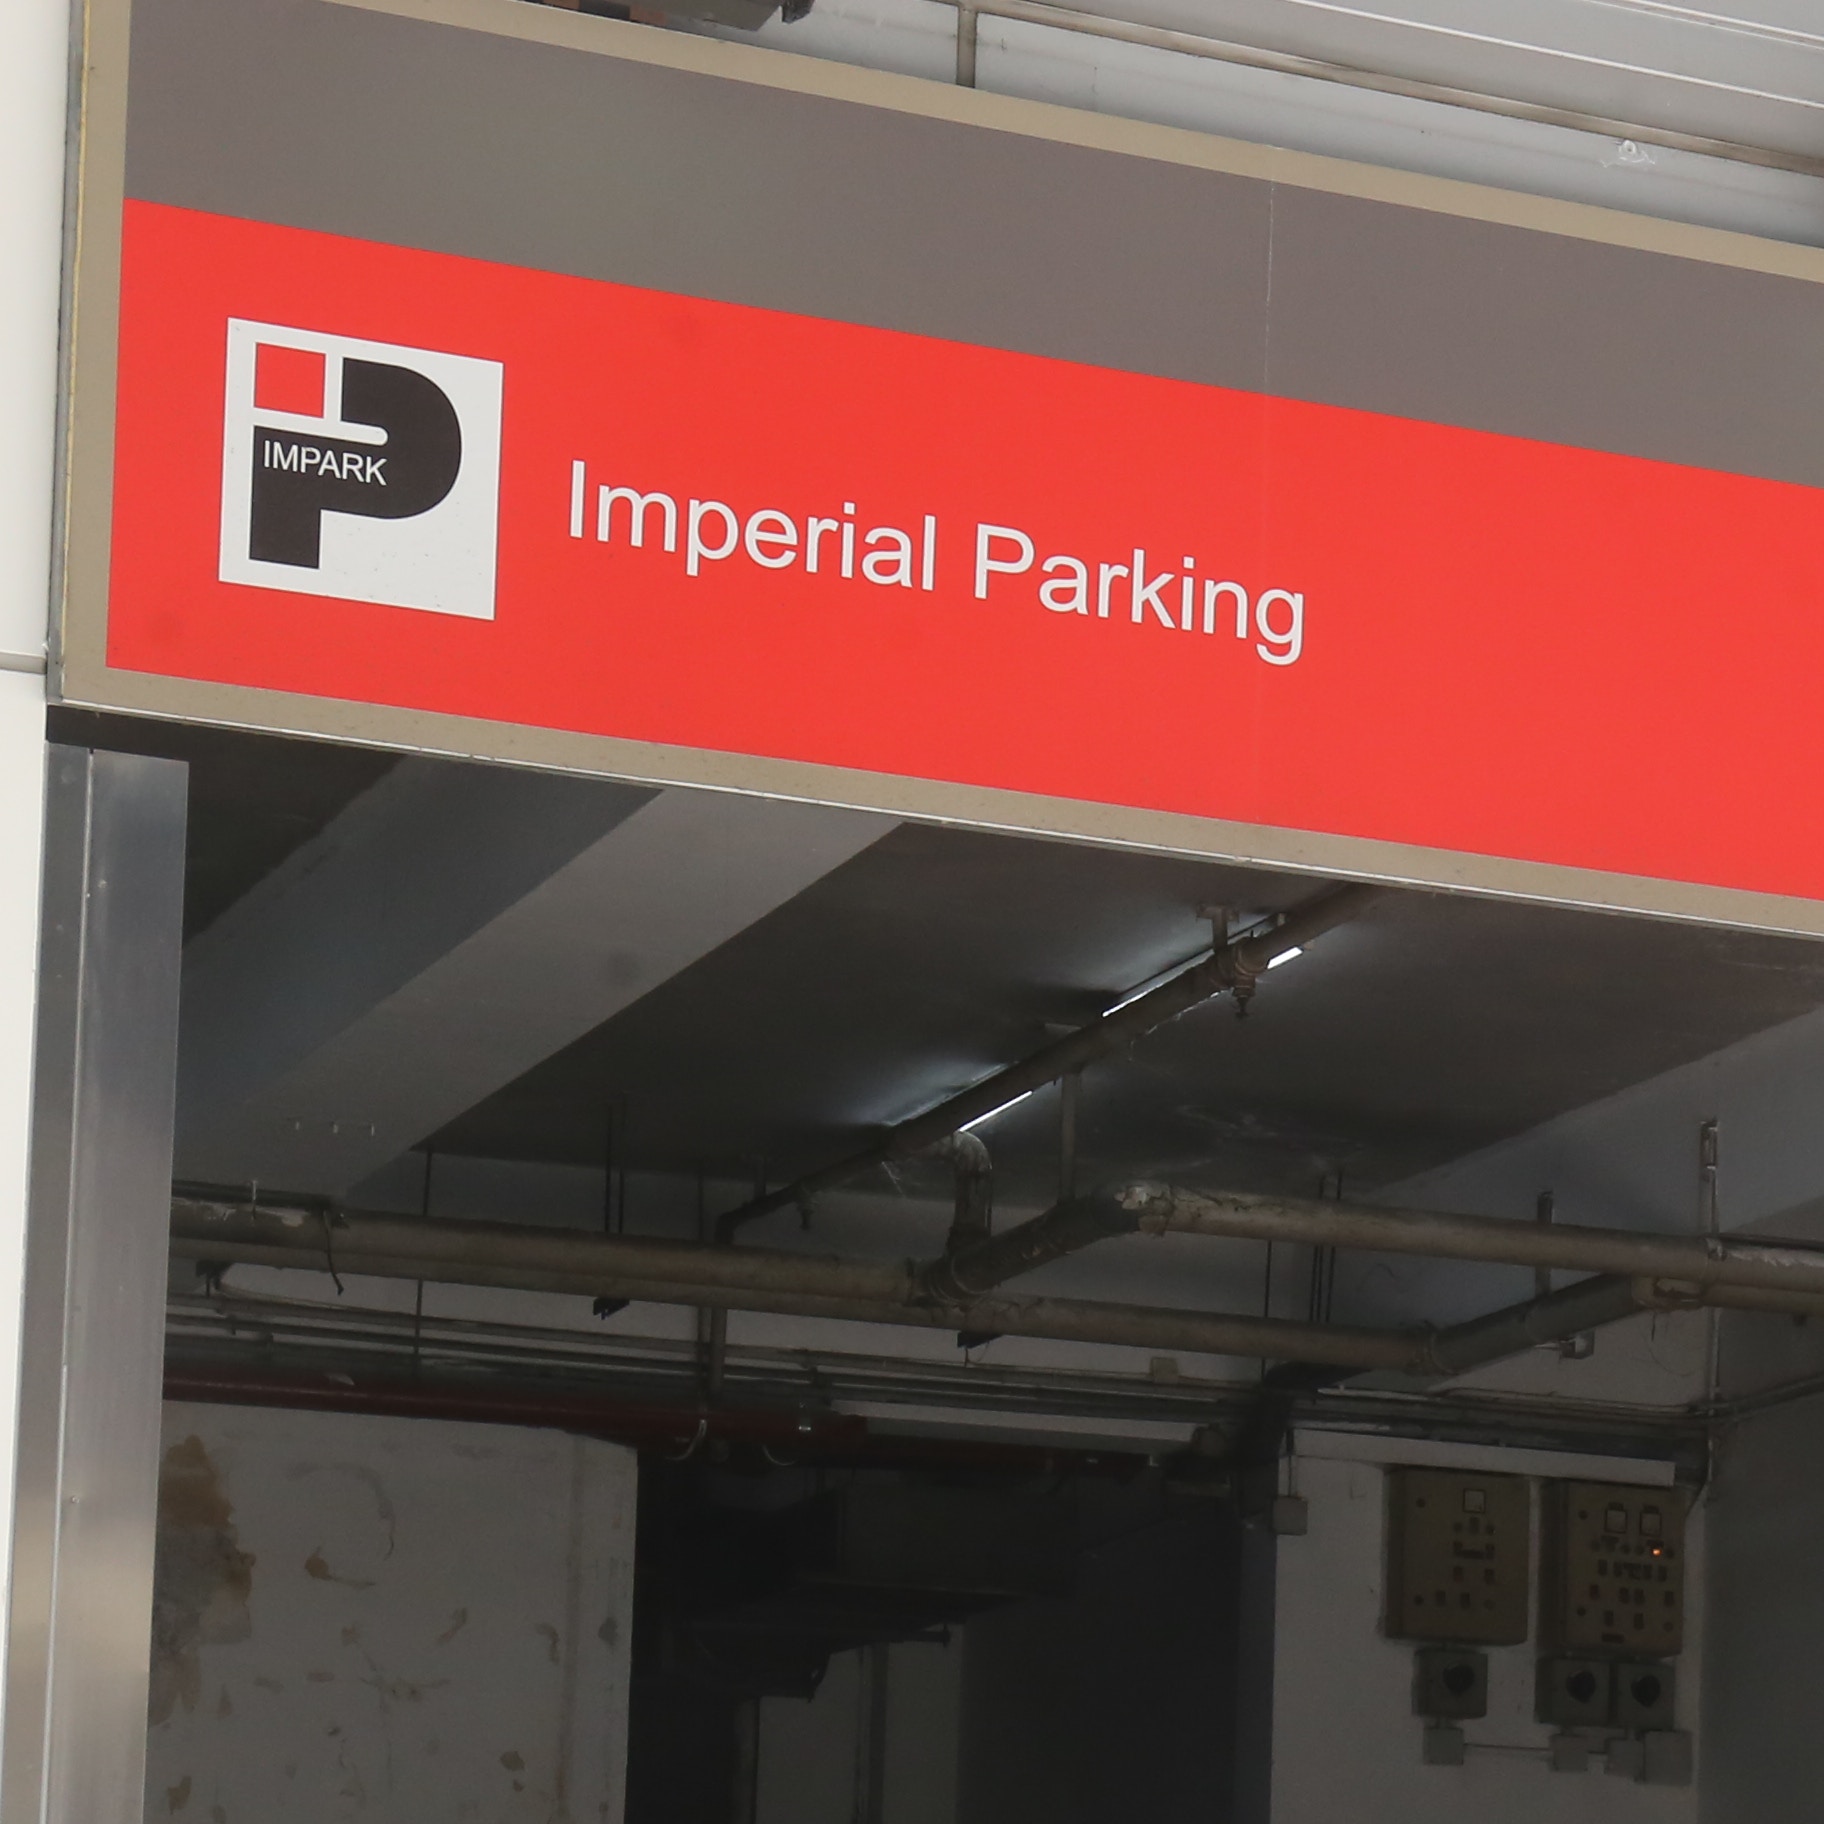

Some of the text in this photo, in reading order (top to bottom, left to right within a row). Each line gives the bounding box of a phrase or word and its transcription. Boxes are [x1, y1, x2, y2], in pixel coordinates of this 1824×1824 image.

[262, 438, 388, 487] IMPARK
[569, 460, 1307, 666] Imperial Parking
